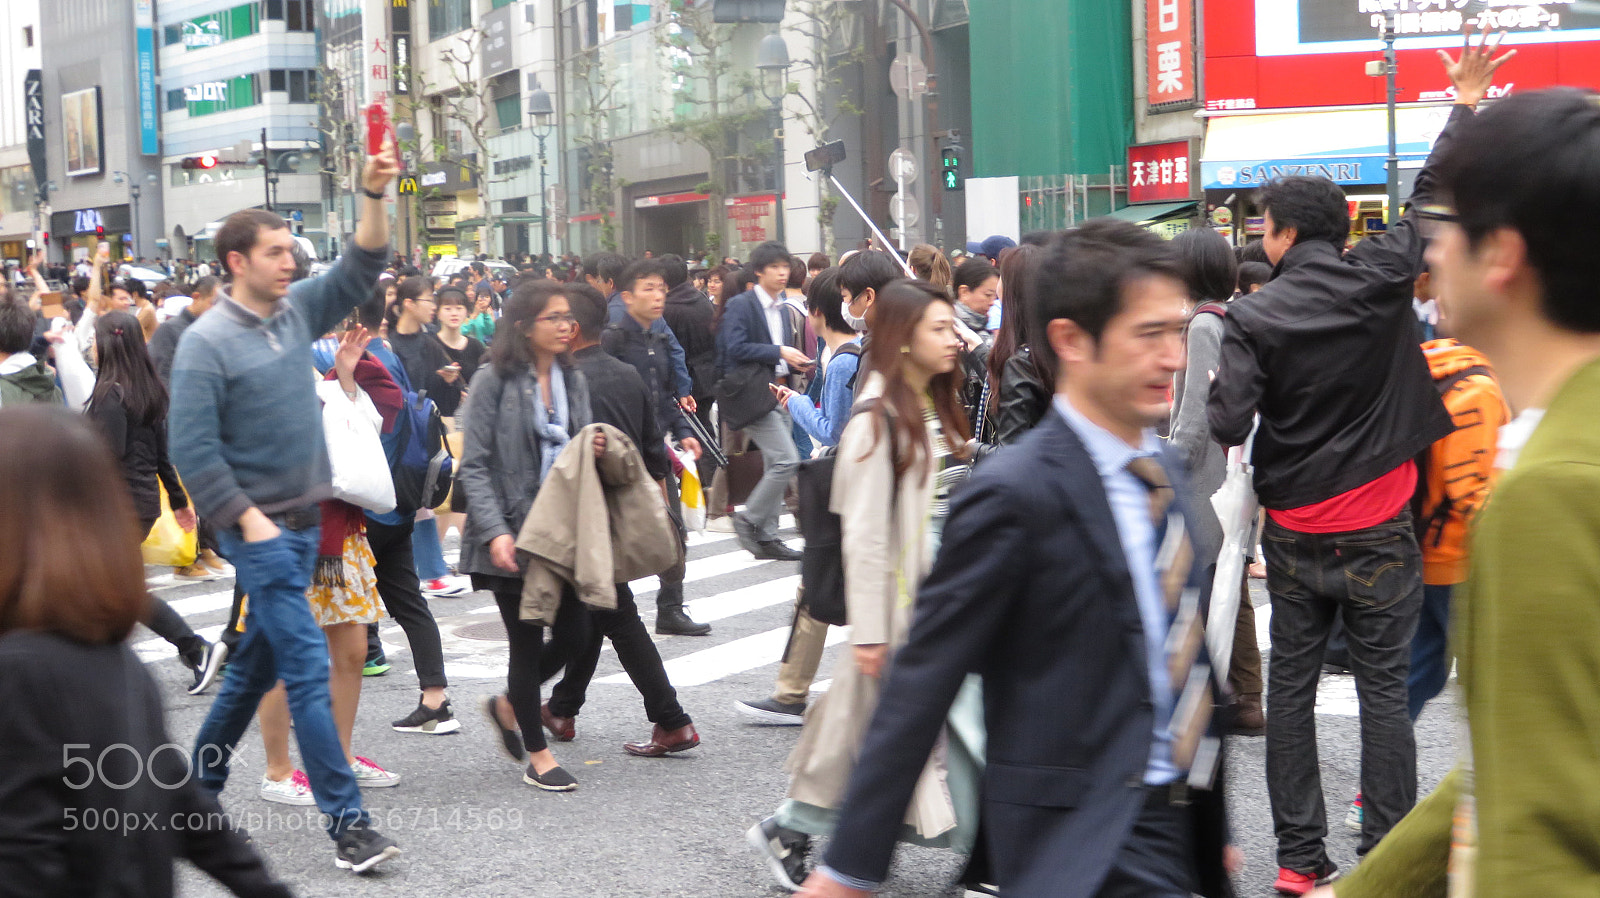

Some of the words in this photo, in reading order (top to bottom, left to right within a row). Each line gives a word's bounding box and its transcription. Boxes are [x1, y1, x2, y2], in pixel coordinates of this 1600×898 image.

[27, 80, 43, 139] ZARA
[1132, 157, 1188, 187] 天津甘栗
[1240, 163, 1362, 183] SANZENRI
